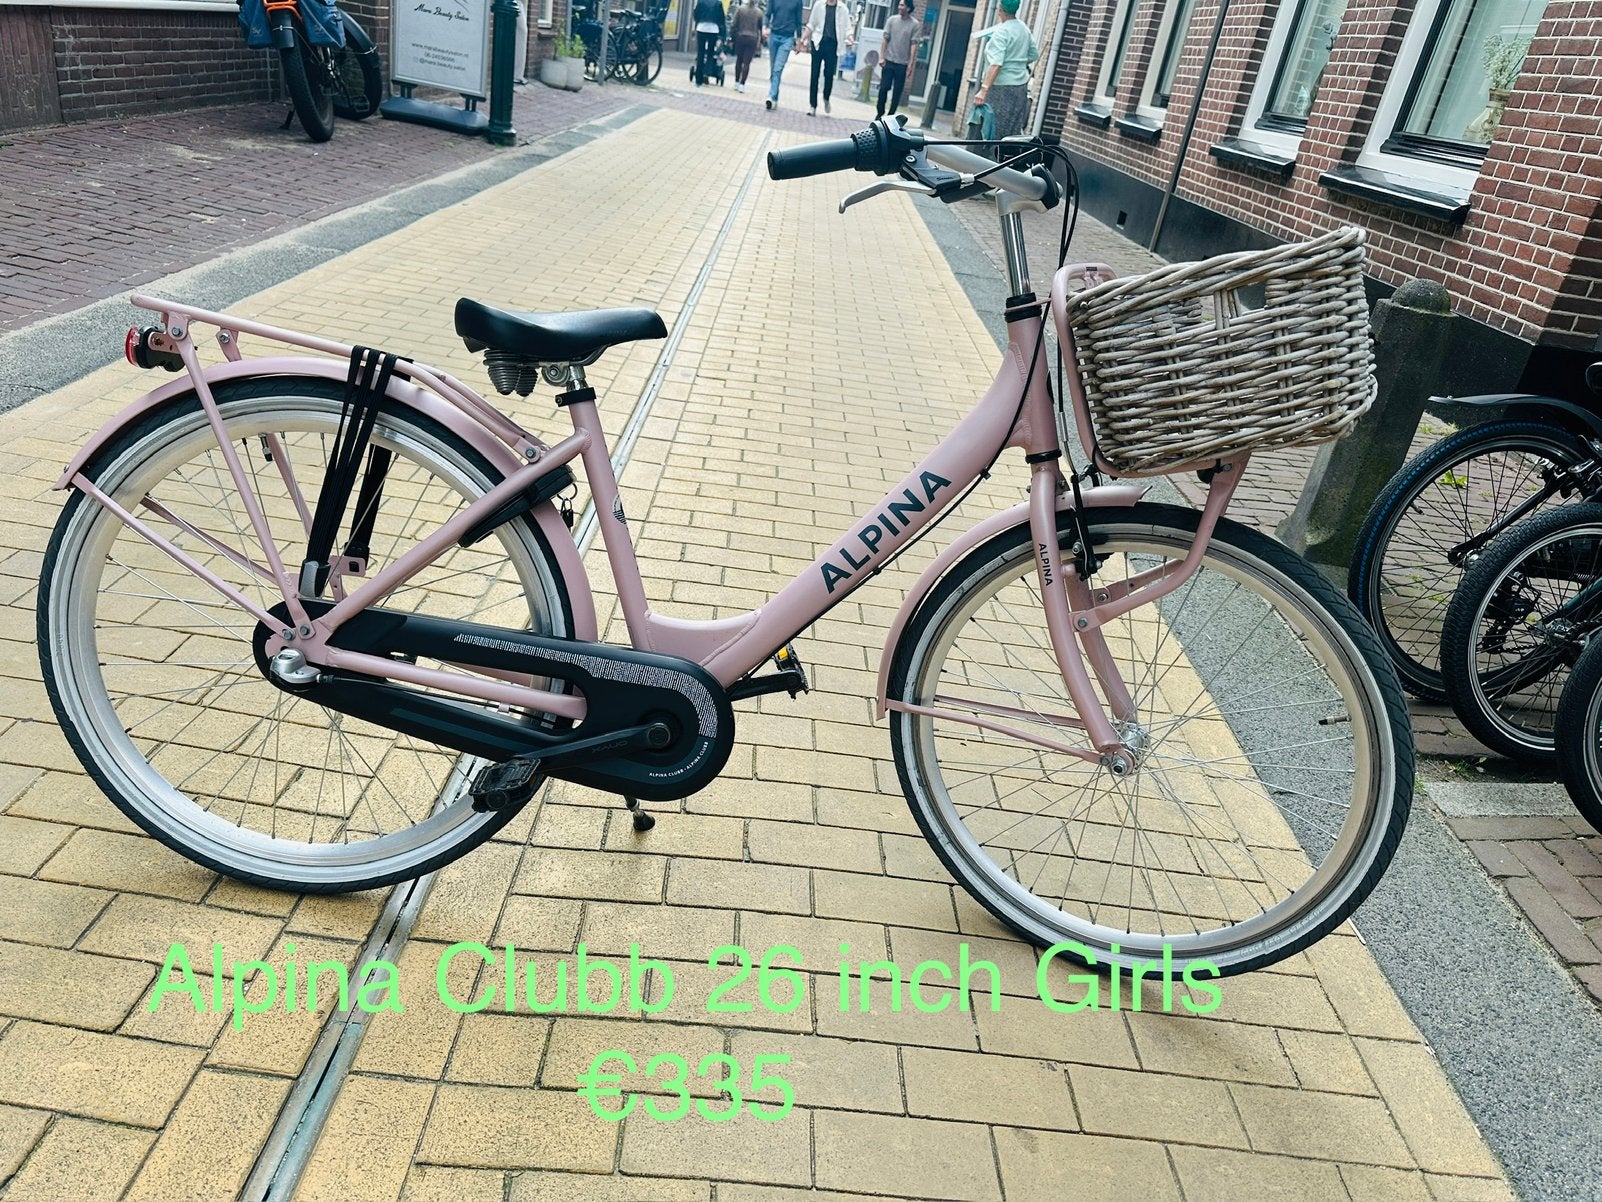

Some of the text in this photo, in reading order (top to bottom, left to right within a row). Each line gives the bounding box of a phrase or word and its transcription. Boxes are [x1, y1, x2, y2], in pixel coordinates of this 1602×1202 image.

[433, 6, 453, 21] Beauty
[454, 11, 470, 21] Salon
[820, 470, 952, 594] ALPINA
[1038, 543, 1053, 587] ALPINA
[686, 756, 701, 769] ALPINA
